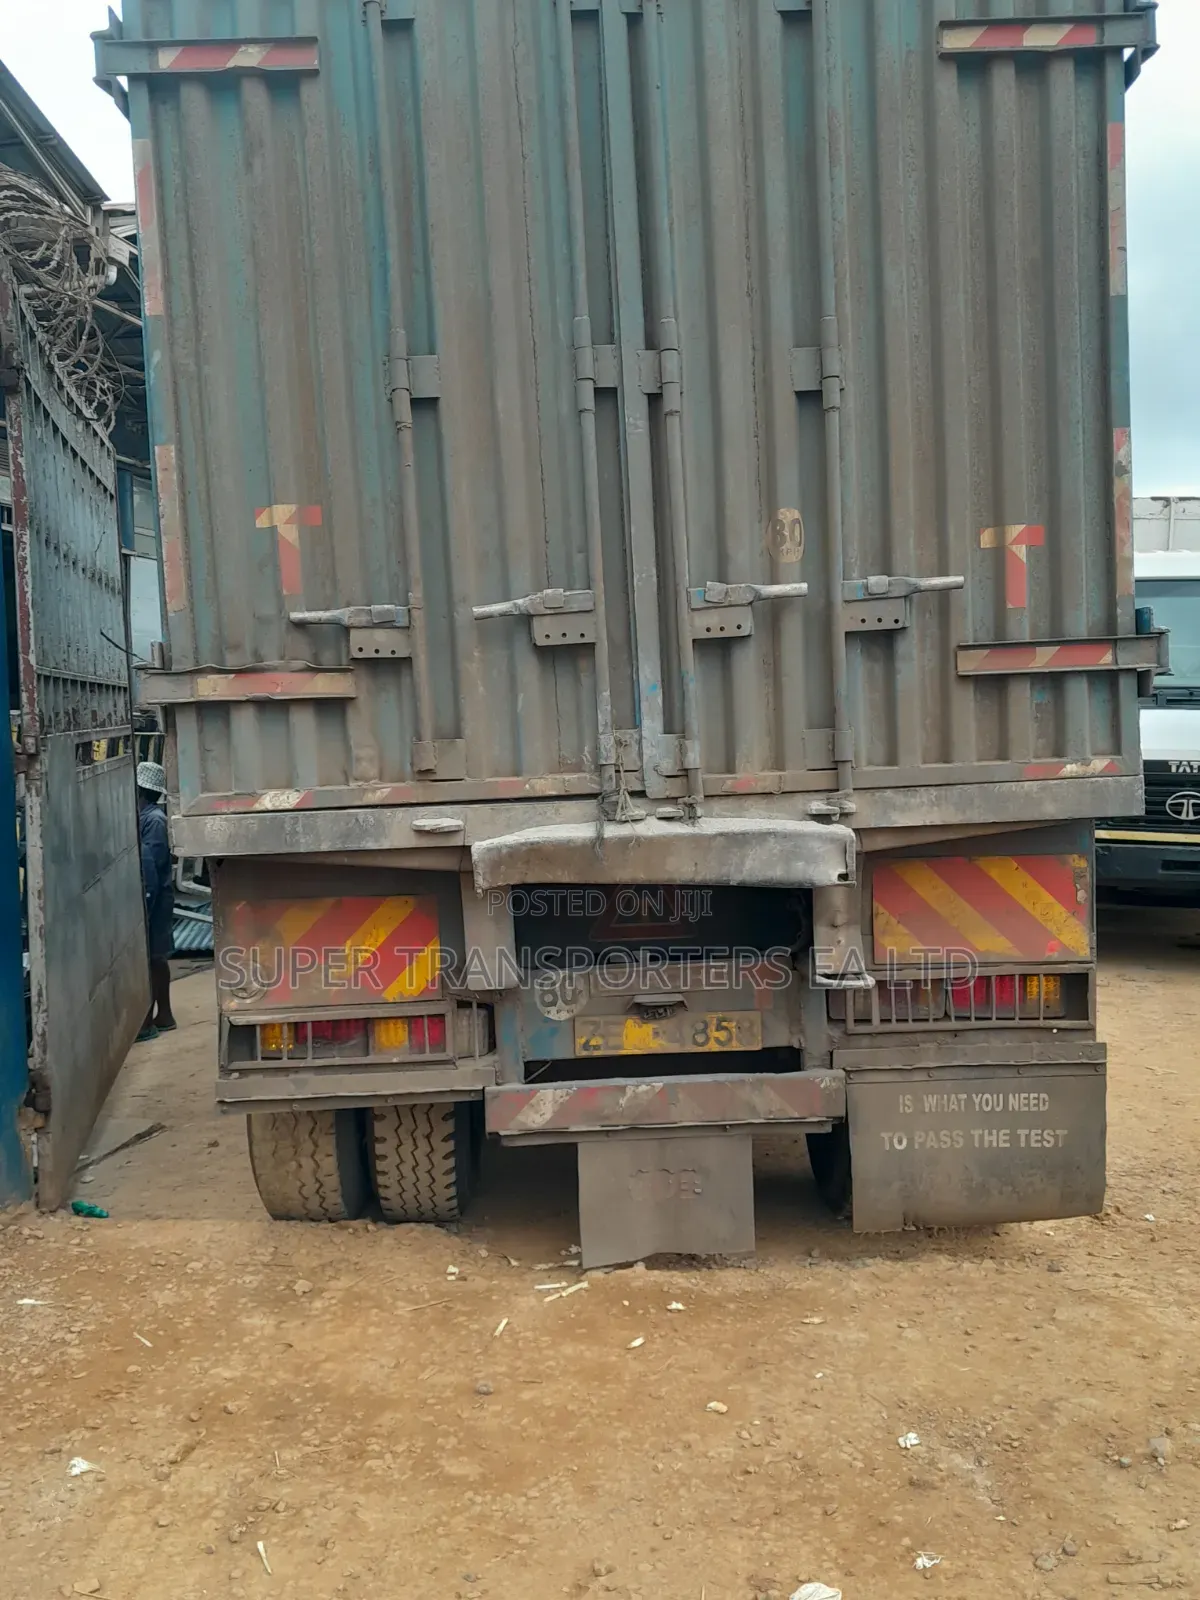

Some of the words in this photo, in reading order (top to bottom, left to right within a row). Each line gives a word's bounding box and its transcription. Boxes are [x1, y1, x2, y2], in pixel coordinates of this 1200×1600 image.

[898, 1093, 915, 1115] IS
[922, 1093, 968, 1114] WHAT
[972, 1092, 1004, 1113] YOU
[1008, 1092, 1051, 1113] NEED
[880, 1131, 908, 1151] TO
[913, 1128, 965, 1150] PASS
[970, 1128, 1011, 1149] THE
[1017, 1128, 1069, 1149] TEST
